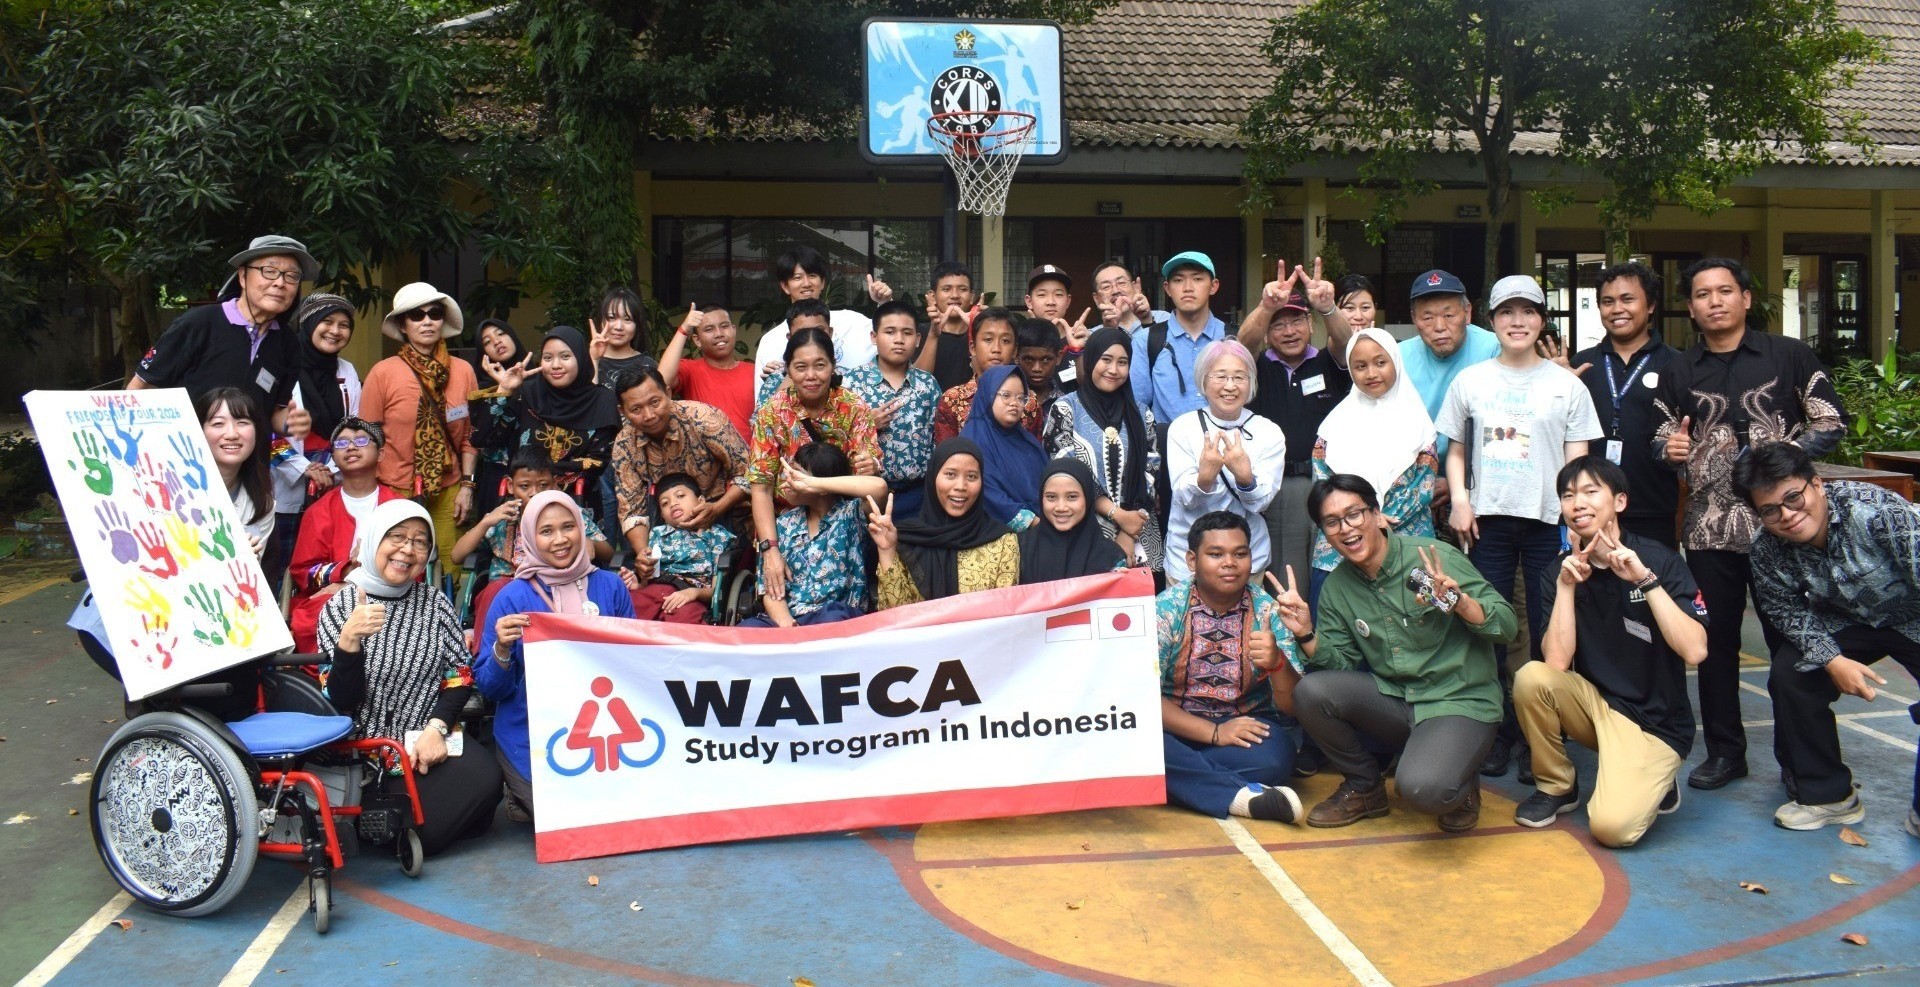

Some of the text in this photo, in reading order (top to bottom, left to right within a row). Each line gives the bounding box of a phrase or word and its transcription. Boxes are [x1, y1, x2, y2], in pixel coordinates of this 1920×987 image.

[937, 67, 994, 91] CORPS
[90, 394, 142, 408] WAFCA
[156, 407, 182, 419] 2026
[663, 659, 982, 728] WAFCA
[685, 706, 1137, 765] Study program in Indonesia
